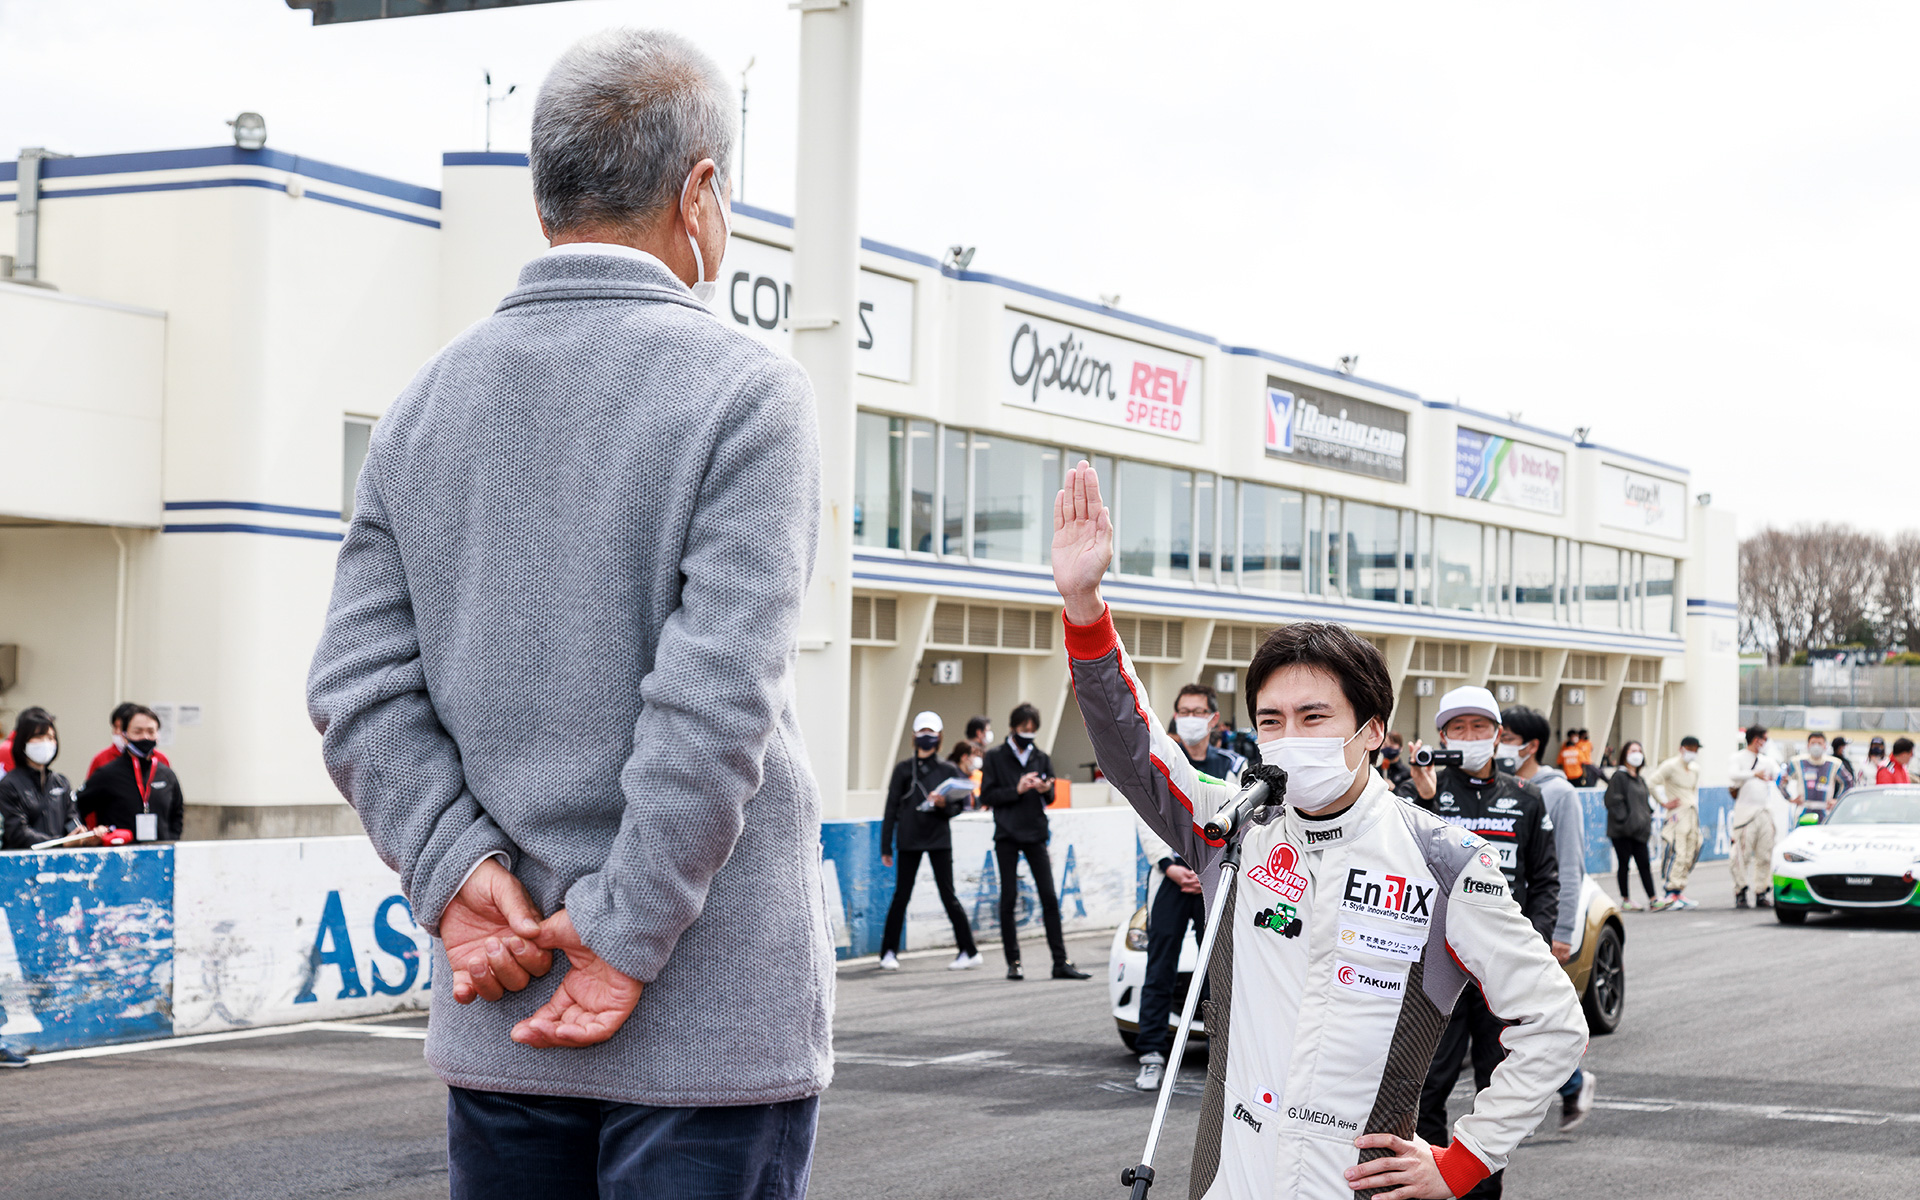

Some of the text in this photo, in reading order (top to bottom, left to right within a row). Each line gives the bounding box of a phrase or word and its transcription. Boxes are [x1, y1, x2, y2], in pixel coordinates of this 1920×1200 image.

[1011, 323, 1116, 403] Option
[1129, 359, 1191, 406] REV
[1126, 400, 1182, 432] SPEED
[1294, 398, 1406, 457] iRacing.com
[944, 663, 953, 681] 9
[1305, 826, 1343, 844] freem
[1248, 866, 1303, 901] Racing
[1276, 866, 1308, 890] Ume
[1343, 868, 1434, 917] EnRiX
[1463, 876, 1504, 897] freem
[1349, 901, 1365, 911] Style
[1400, 912, 1429, 926] Company
[293, 890, 432, 1004] AS
[1358, 974, 1401, 991] TAKUMI
[1233, 1102, 1262, 1133] freem
[1288, 1107, 1358, 1131] G.UMEDA RH+B
